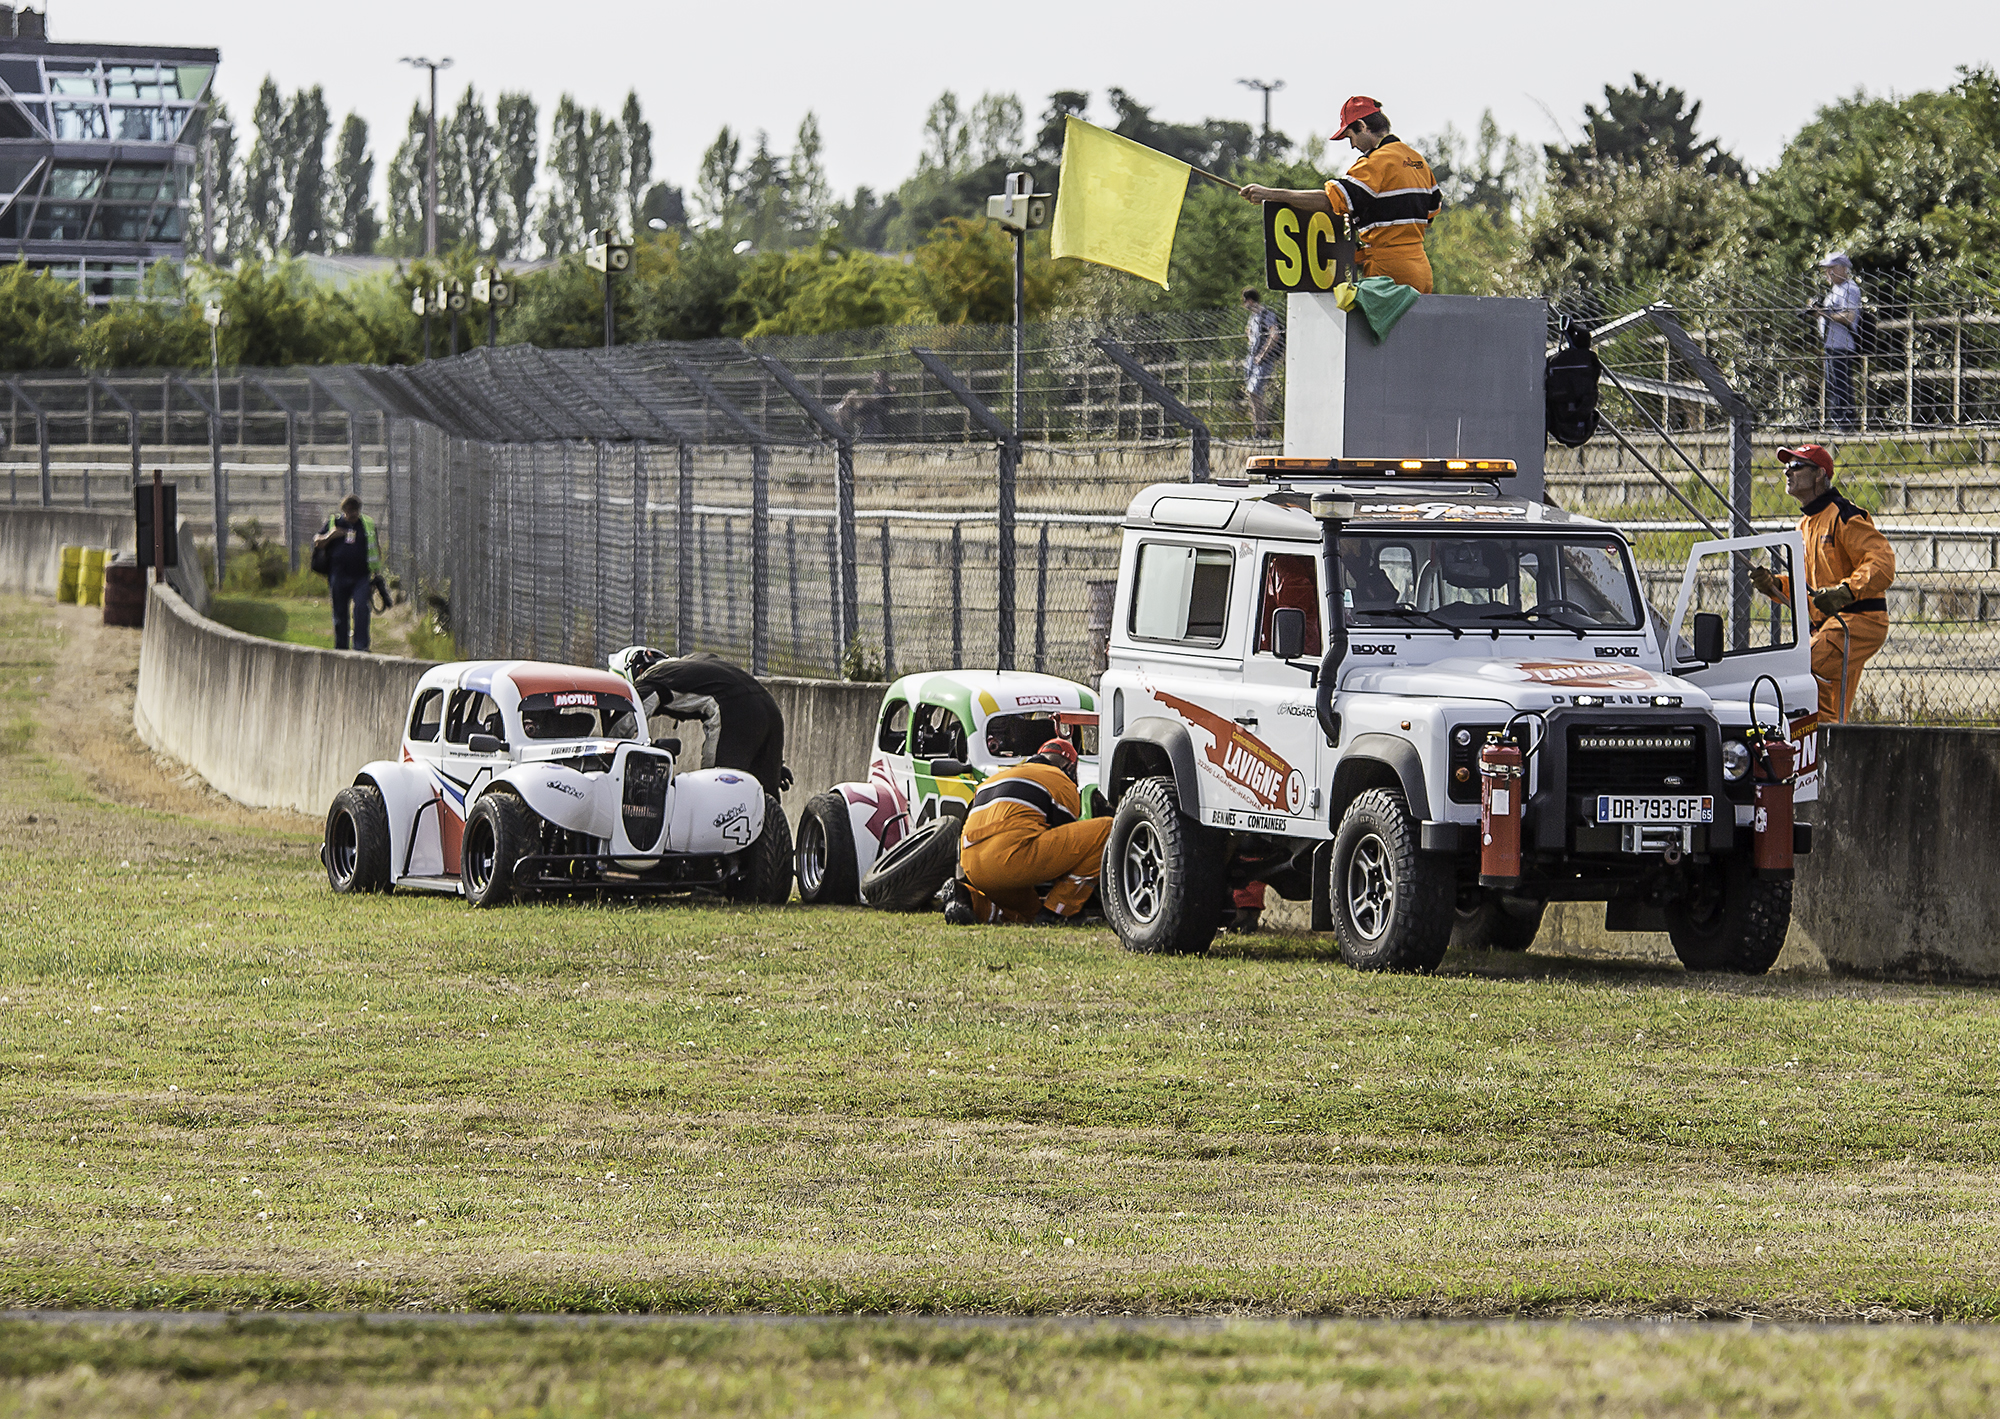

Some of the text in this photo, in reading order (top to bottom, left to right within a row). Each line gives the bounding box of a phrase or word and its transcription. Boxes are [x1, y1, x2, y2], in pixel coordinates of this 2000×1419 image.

[1274, 207, 1338, 290] SC
[1533, 663, 1627, 682] LAVIGNE
[556, 694, 596, 706] MOTUL
[1018, 696, 1059, 706] MOTUL
[1288, 706, 1317, 718] NOGARO
[1223, 740, 1284, 803] LAVIGNE
[1613, 799, 1698, 819] DR-793-GF
[1702, 810, 1712, 819] 65
[723, 816, 751, 845] 4
[1212, 811, 1287, 832] BENNES CONTAINERS
